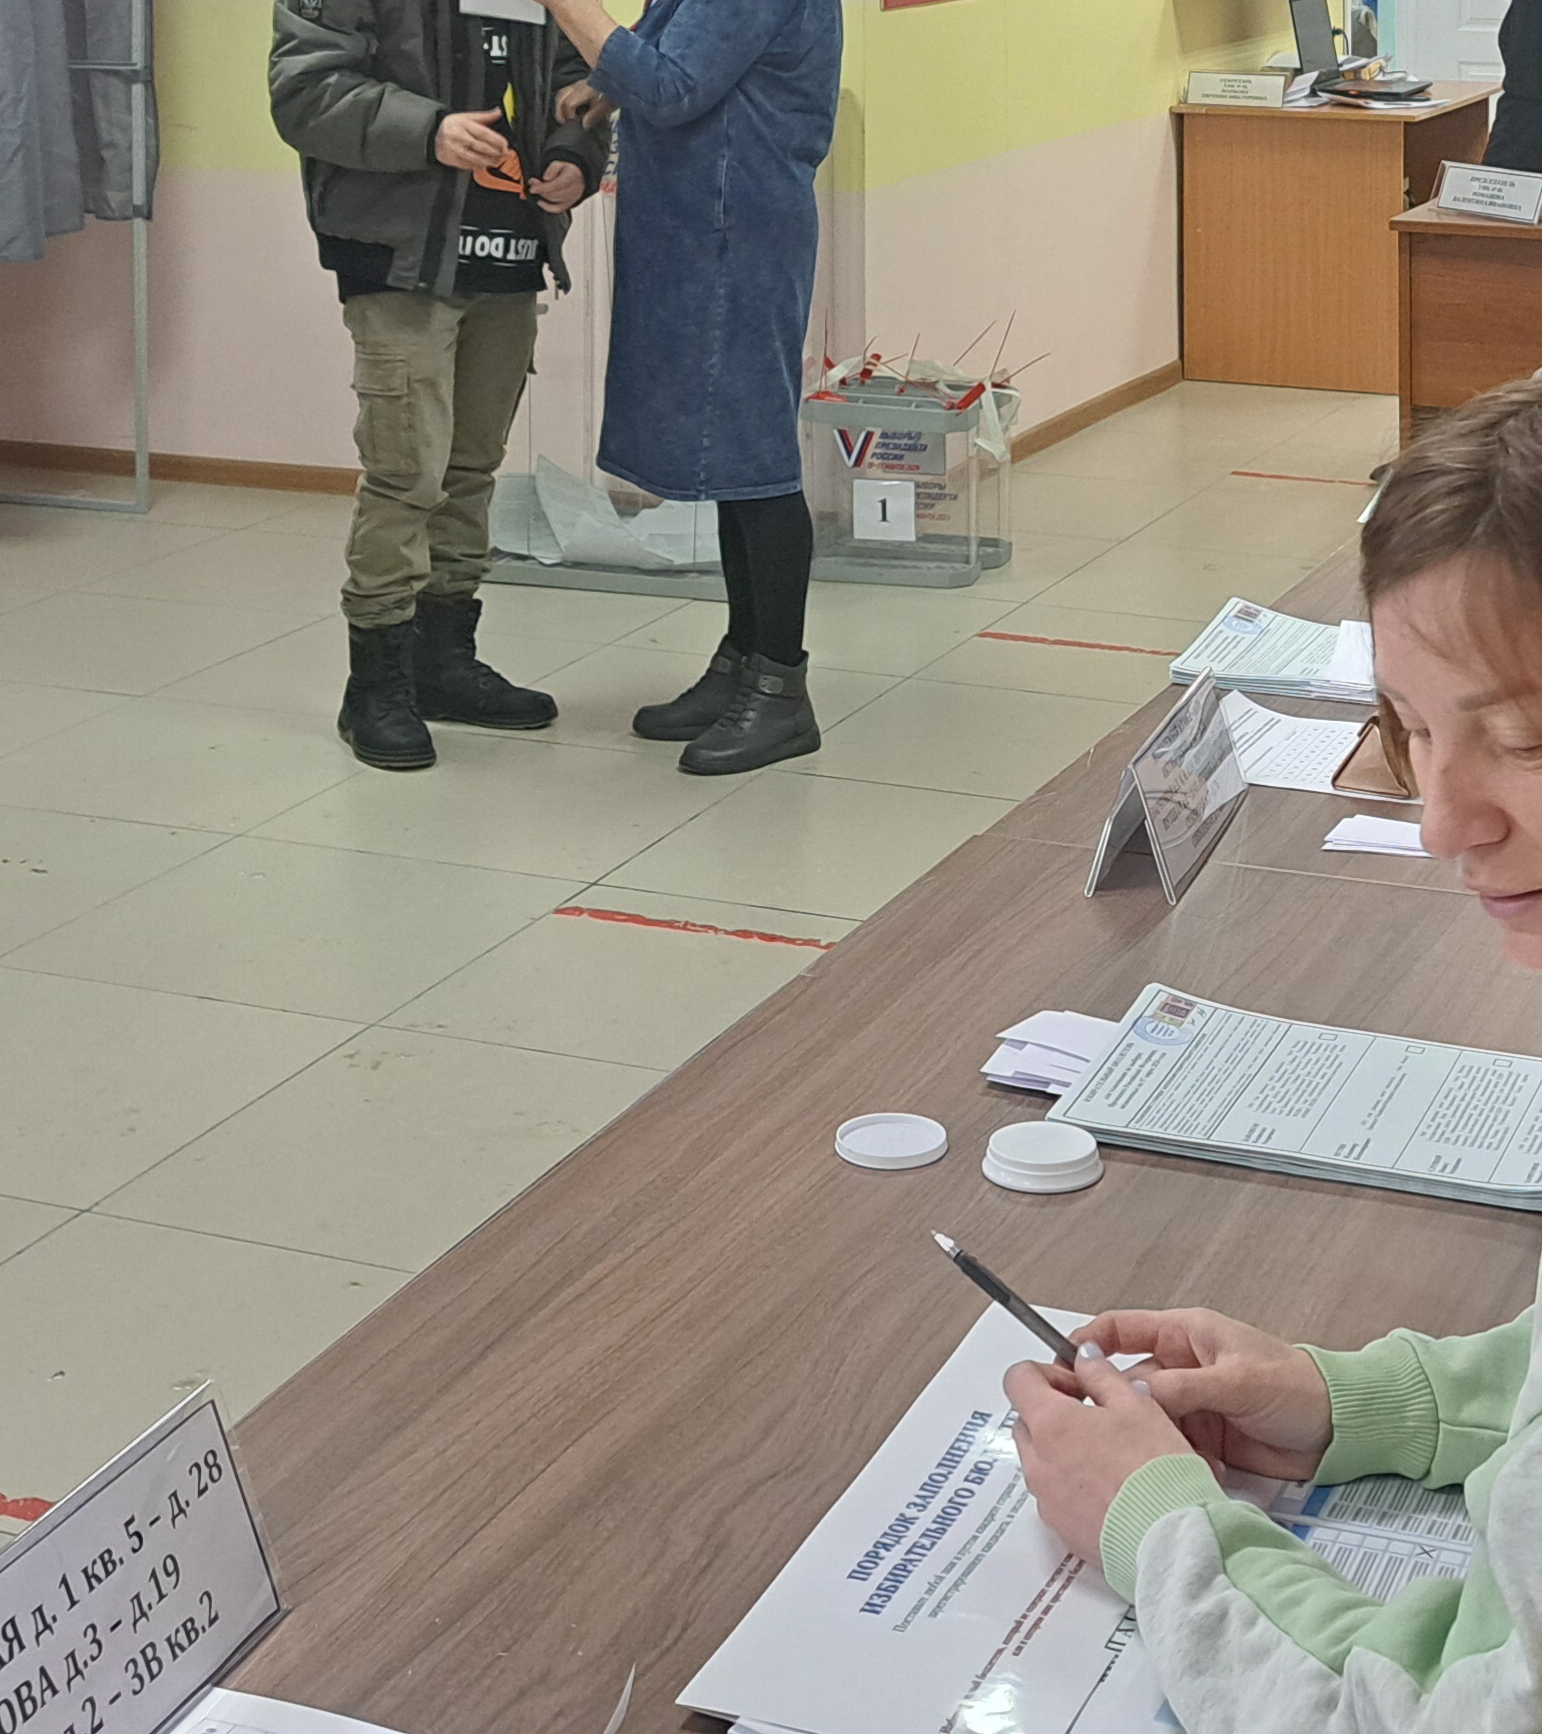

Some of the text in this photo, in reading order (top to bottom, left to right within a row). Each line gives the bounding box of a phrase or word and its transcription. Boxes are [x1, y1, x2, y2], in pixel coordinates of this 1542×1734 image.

[474, 235, 505, 259] DO
[878, 497, 890, 522] 1
[31, 1603, 57, 1648] д.
[58, 1572, 81, 1612] 1
[81, 1547, 124, 1594] кв.
[123, 1514, 144, 1554] 5
[167, 1489, 190, 1530] д.
[188, 1449, 223, 1499] 28
[846, 1410, 993, 1582] ПОРЯДОК ЗАПОЛНЕНИЯ
[858, 1487, 975, 1616] ИЗБИРАТЕЛЬНОГО
[63, 1622, 103, 1694] д.3
[130, 1553, 180, 1634] д.19
[164, 1590, 220, 1662] кв.2
